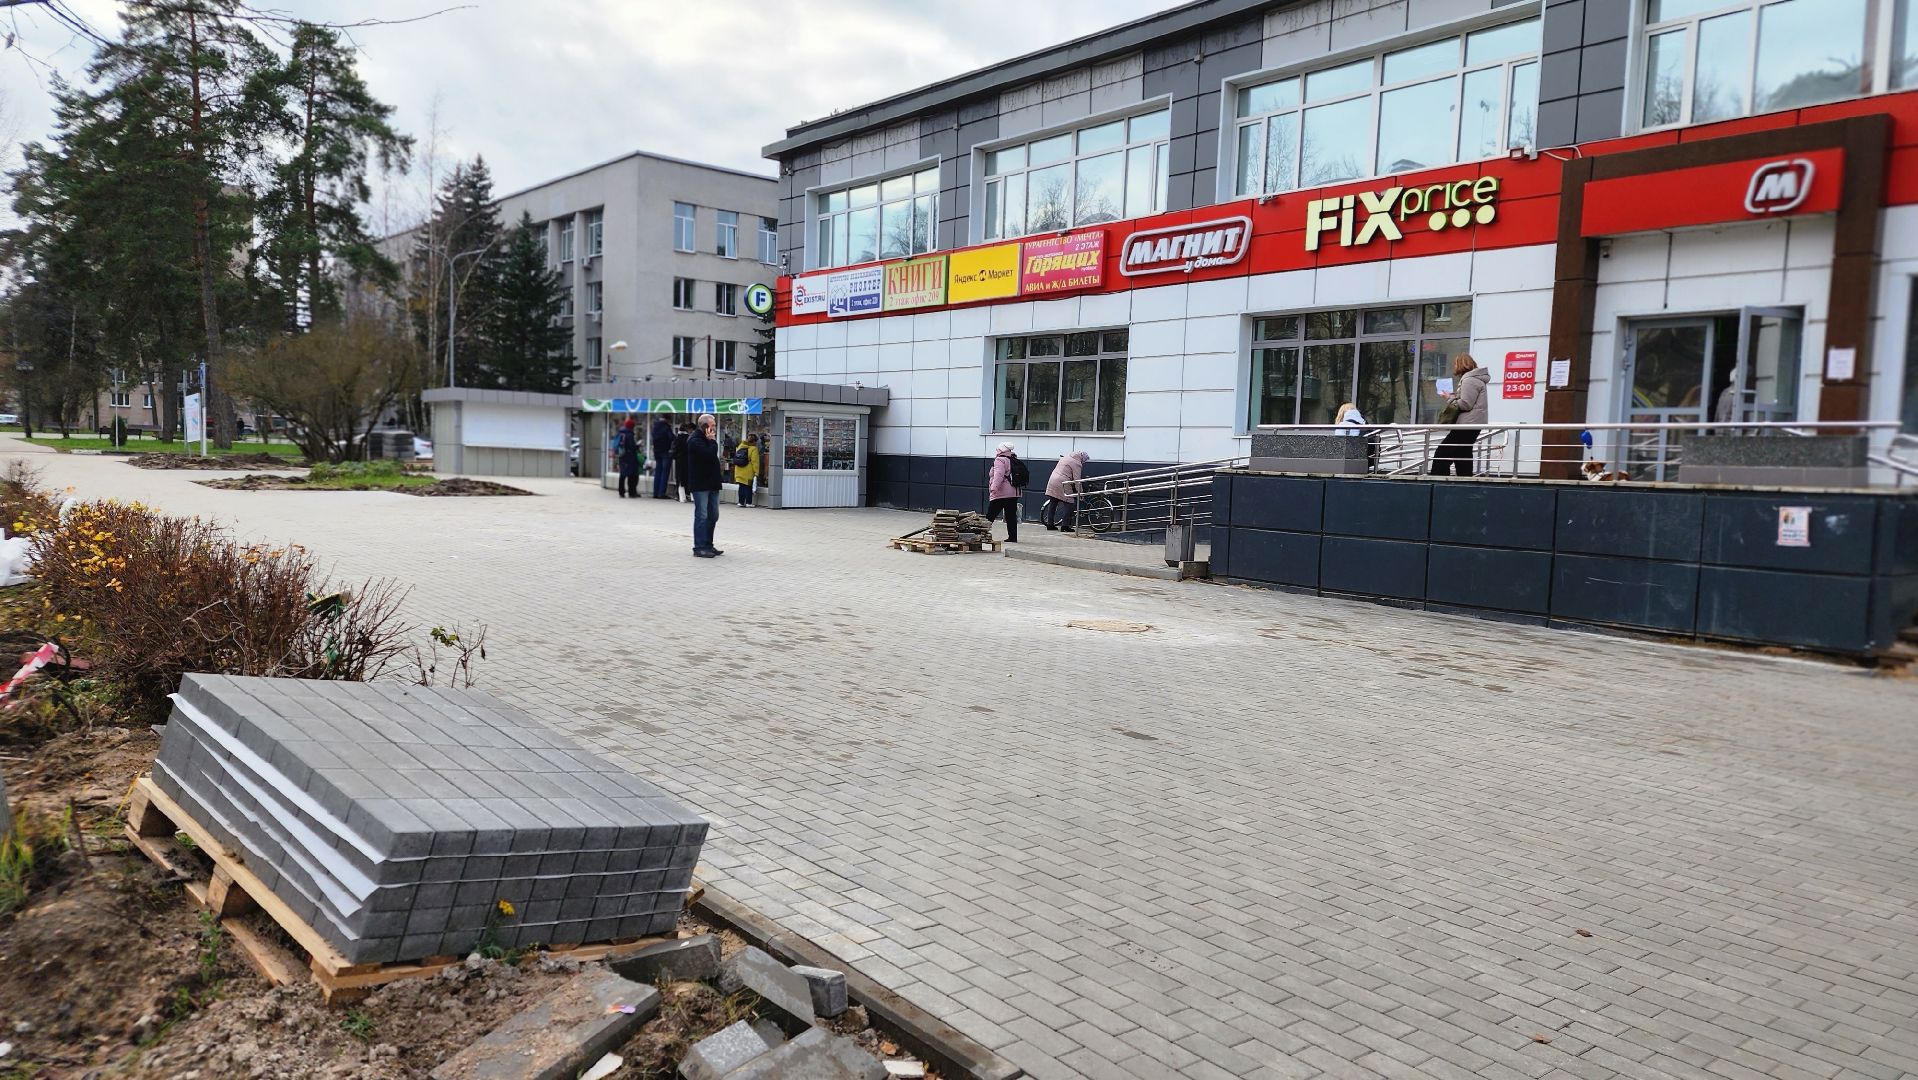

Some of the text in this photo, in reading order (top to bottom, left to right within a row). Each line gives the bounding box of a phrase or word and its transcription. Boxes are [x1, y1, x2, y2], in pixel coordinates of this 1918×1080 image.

[1400, 176, 1499, 222] price
[1025, 231, 1104, 250] ТУРАГЕНТСТВО «МЕЧТА»
[1075, 240, 1100, 251] 2 ЭТАЖ
[1127, 226, 1242, 266] МАГНИТ
[1183, 256, 1226, 273] у дома
[888, 260, 943, 295] КНИГИ
[954, 269, 1014, 284] Яндекс Маркет
[1025, 275, 1100, 293] АВИА и Ж/Д БИЛЕТЫ
[1506, 371, 1533, 379] 08:00
[1506, 383, 1532, 392] 23:00
